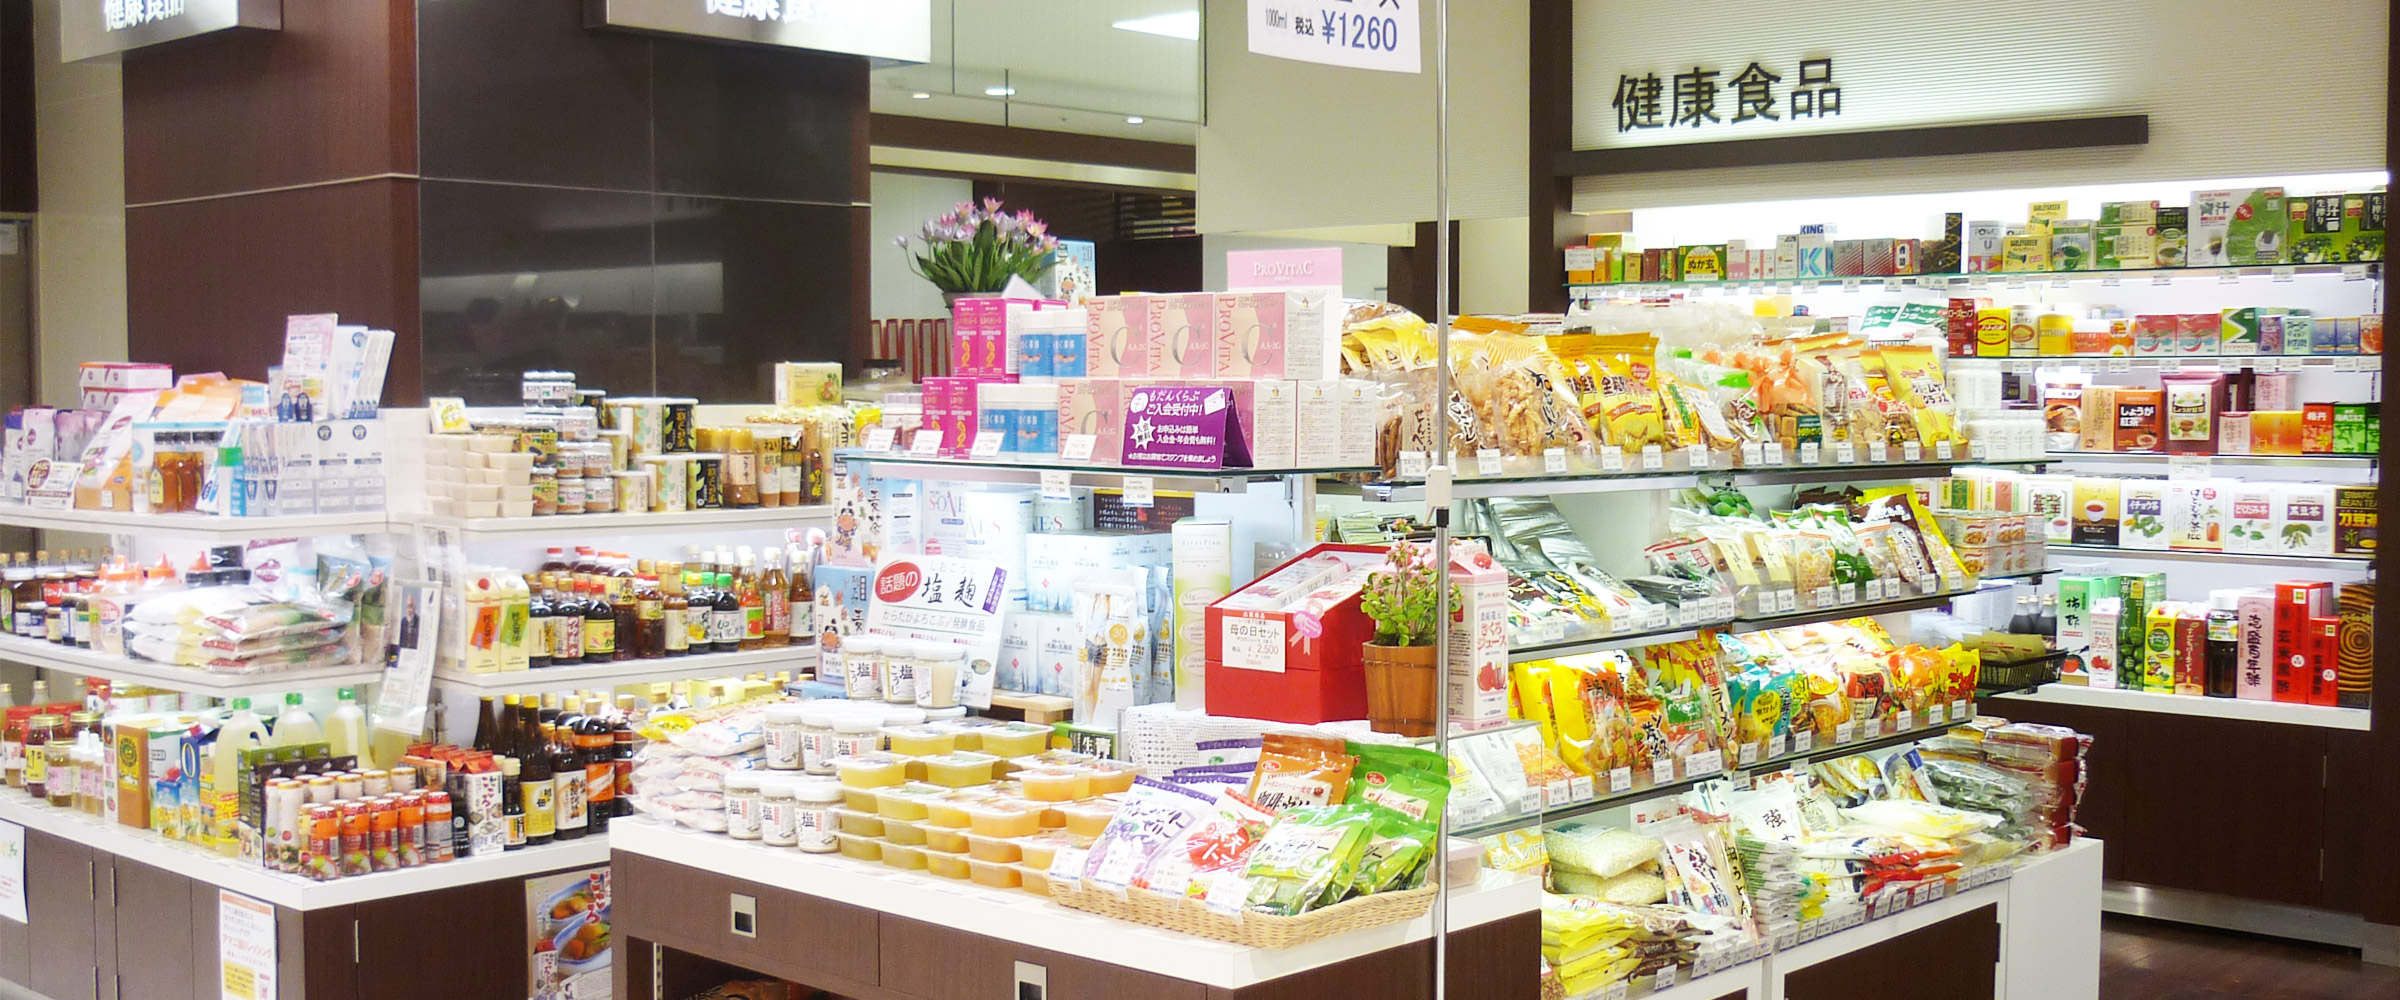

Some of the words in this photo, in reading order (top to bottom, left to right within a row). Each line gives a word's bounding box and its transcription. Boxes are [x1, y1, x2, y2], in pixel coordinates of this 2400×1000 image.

[1295, 17, 1314, 36] 税込
[1322, 9, 1398, 51] ¥1260
[1612, 58, 1842, 133] 健康食品
[1800, 225, 1824, 235] KING
[1688, 259, 1714, 269] ぬか玄
[1149, 389, 1200, 402] もだんくらぶ
[1147, 402, 1203, 416] ご入会受付中!
[2120, 406, 2154, 416] しょうが
[1137, 422, 1149, 434] 入会
[2119, 417, 2140, 428] 紅茶
[2340, 499, 2363, 507] BEAN
[930, 560, 977, 575] しおこうじ
[880, 571, 918, 595] 話題の
[1112, 627, 1126, 640] 30
[1230, 624, 1280, 639] 母の日セット
[1480, 622, 1503, 637] ざくろ
[1257, 643, 1279, 655] 2,500
[1477, 634, 1507, 650] ジュース
[858, 662, 871, 677] 塩
[900, 664, 914, 680] 塩
[890, 664, 901, 696] こうじ
[1702, 656, 1734, 740] 中華ラーメン
[1650, 714, 1670, 755] ソース
